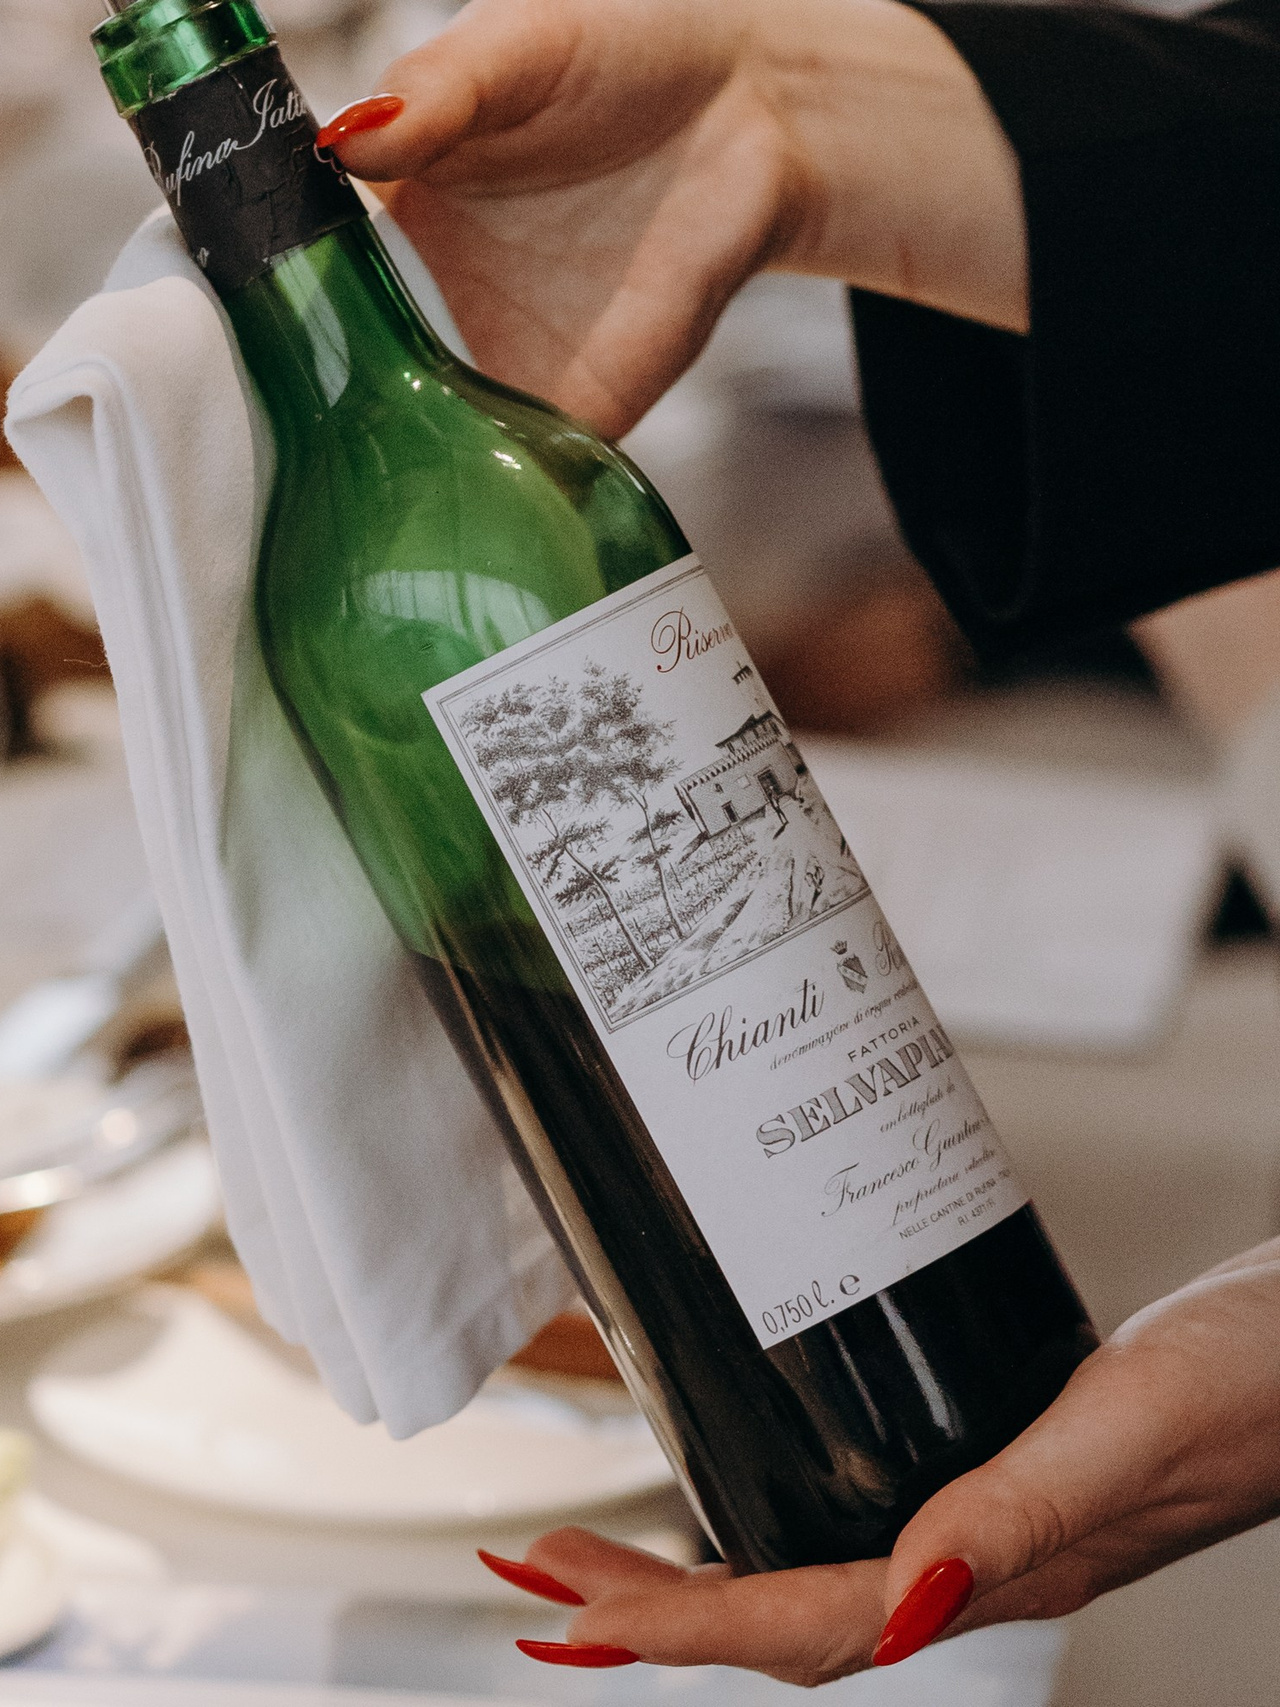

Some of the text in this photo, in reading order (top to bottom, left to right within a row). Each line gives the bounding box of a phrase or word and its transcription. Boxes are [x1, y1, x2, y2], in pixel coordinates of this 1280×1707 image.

[666, 978, 825, 1086] Chianti
[847, 1016, 920, 1062] FATTORIA
[756, 1023, 954, 1159] SELVAPIA
[821, 1162, 920, 1217] Francesco
[899, 1219, 928, 1240] NELLE
[929, 1196, 966, 1224] CANTINE
